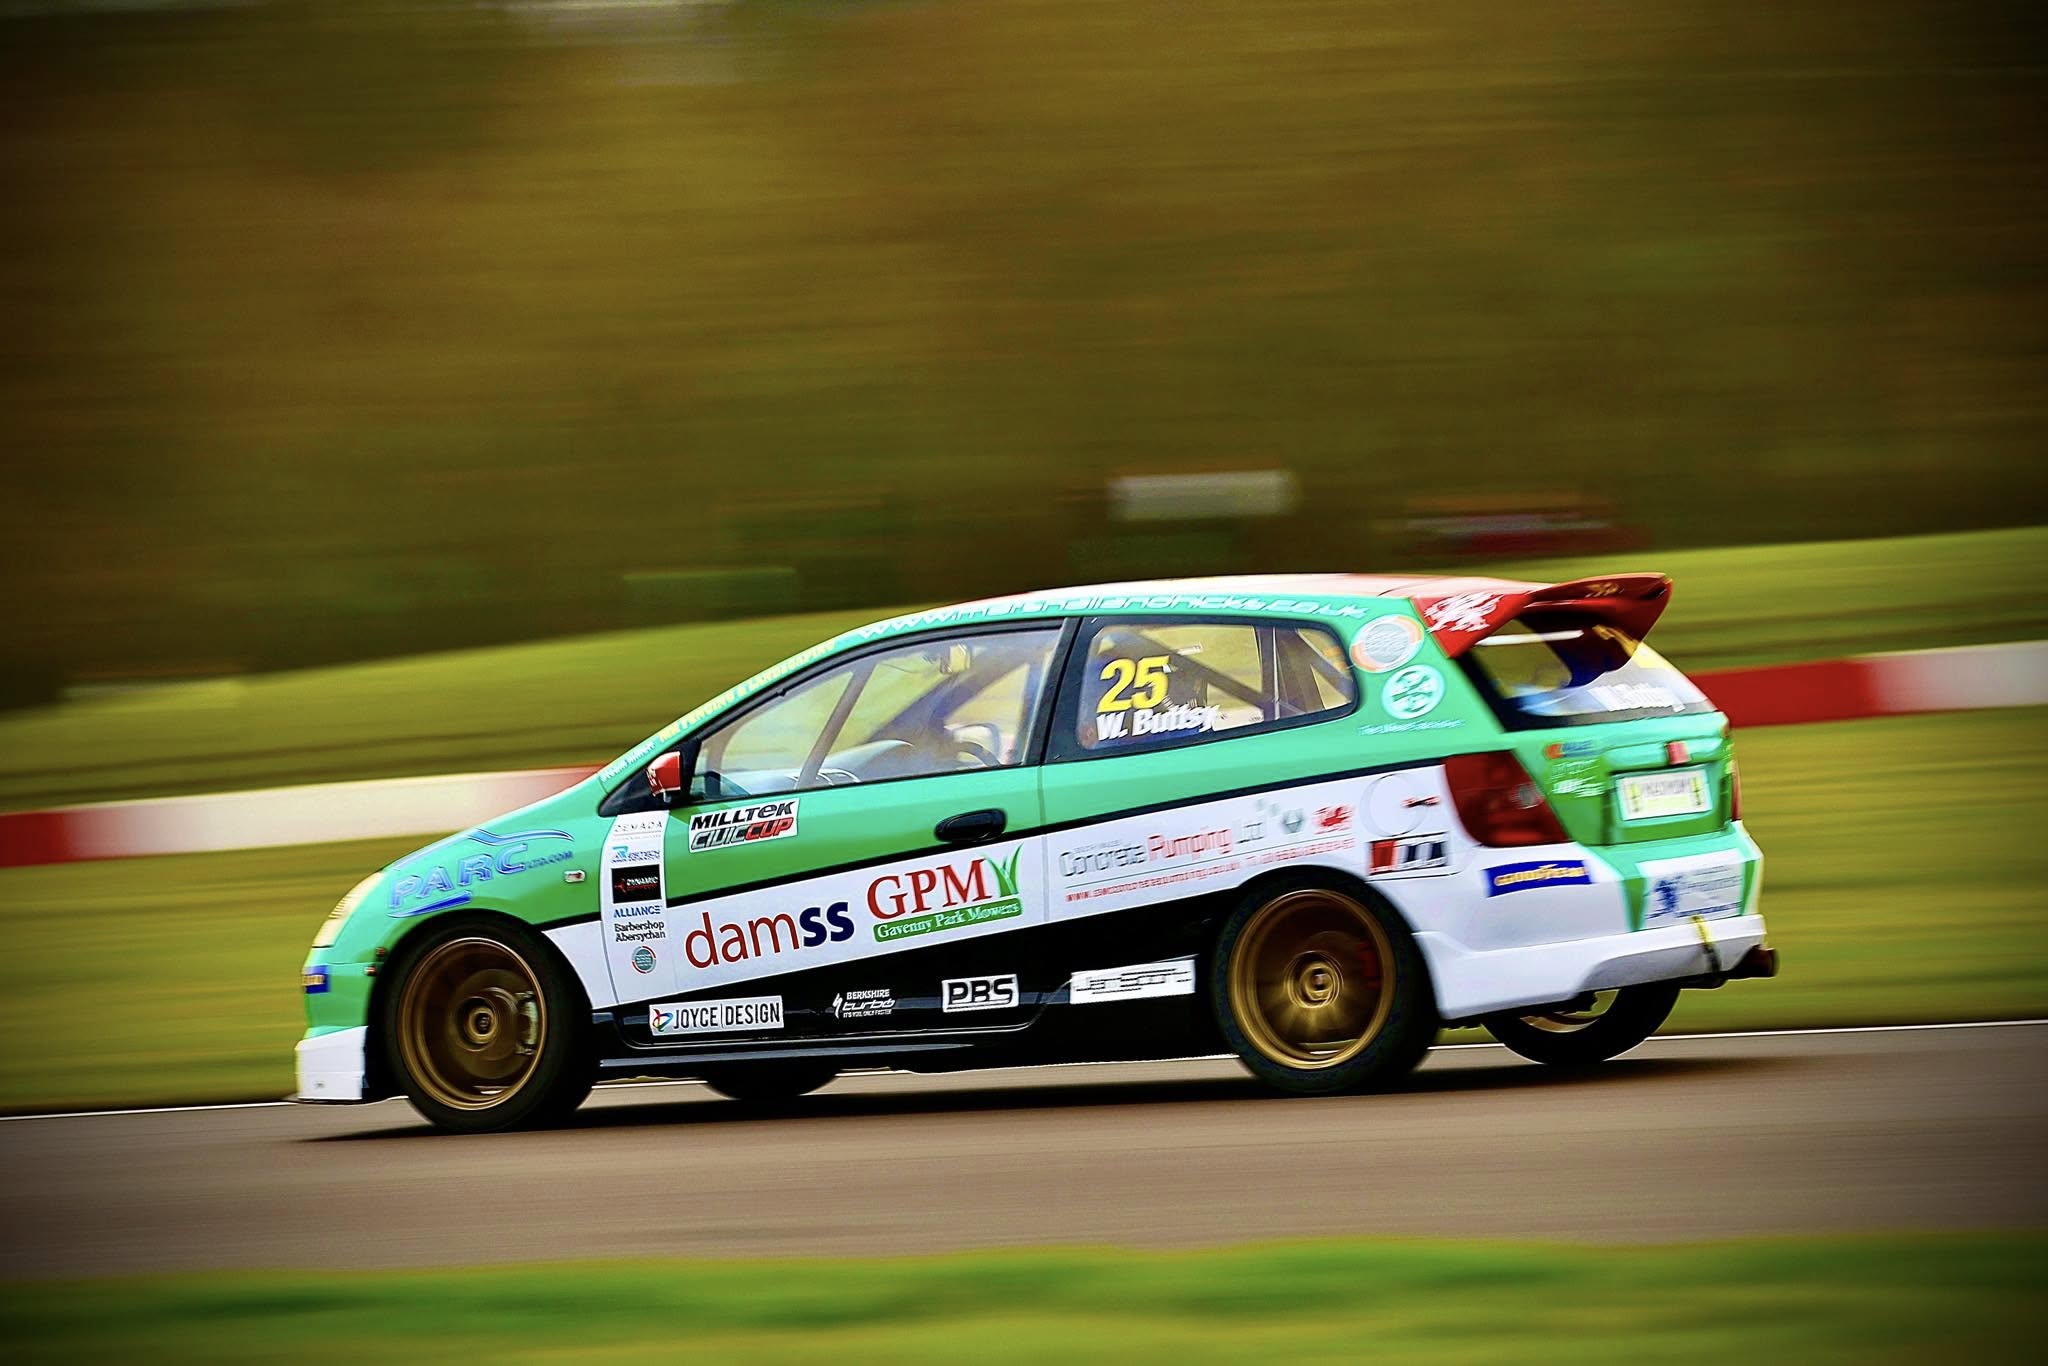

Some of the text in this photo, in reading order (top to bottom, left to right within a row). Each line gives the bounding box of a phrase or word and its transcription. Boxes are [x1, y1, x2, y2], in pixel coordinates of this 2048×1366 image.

[1096, 655, 1171, 713] 25
[1096, 711, 1129, 741] W.
[744, 816, 794, 841] CUP
[1058, 844, 1147, 877] Concrete
[1147, 828, 1232, 861] Pumping
[388, 842, 528, 909] PARC
[866, 858, 993, 920] GPM
[613, 905, 662, 918] ALLIANCE
[876, 902, 1020, 940] Gavenny Park Mowers
[614, 920, 665, 932] Barbershop
[615, 930, 666, 942] Abersychan
[685, 901, 855, 969] damss
[842, 998, 896, 1011] turbo
[846, 988, 891, 1001] BERKSHIRE
[673, 1002, 781, 1029] JOYCE DESIGN
